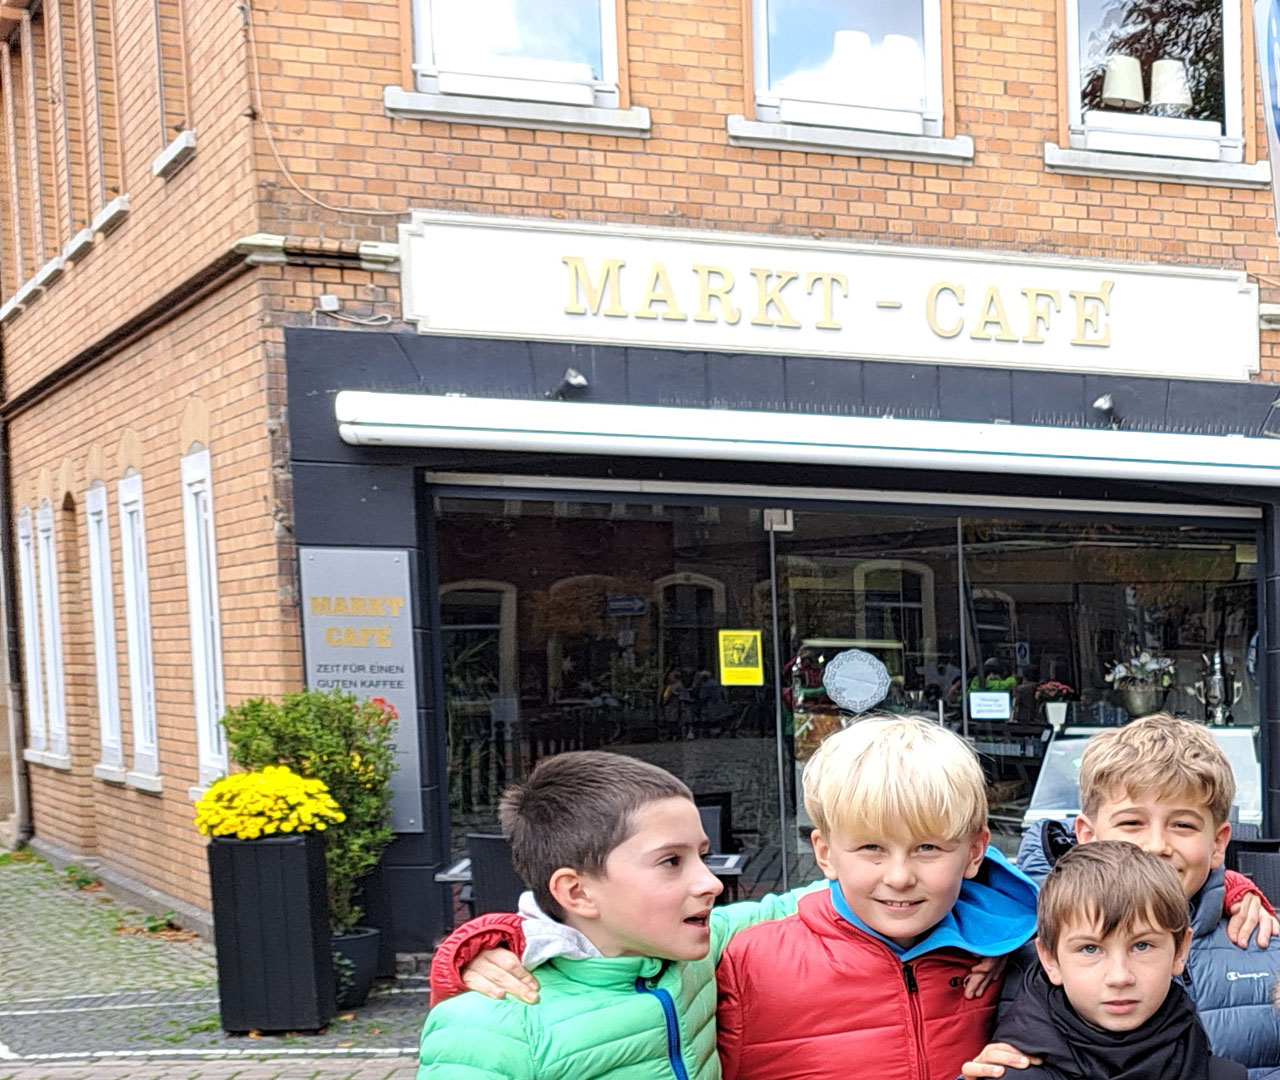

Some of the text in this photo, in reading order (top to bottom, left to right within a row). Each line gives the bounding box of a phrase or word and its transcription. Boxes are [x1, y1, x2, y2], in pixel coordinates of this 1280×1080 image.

[562, 255, 849, 330] MARKT
[926, 280, 1114, 348] CAFÉ
[309, 596, 404, 617] MARKT
[325, 624, 393, 648] CAFÉ
[316, 662, 405, 674] ZEIT FÜR EINEN
[317, 679, 405, 689] GUTEN KAFFEE
